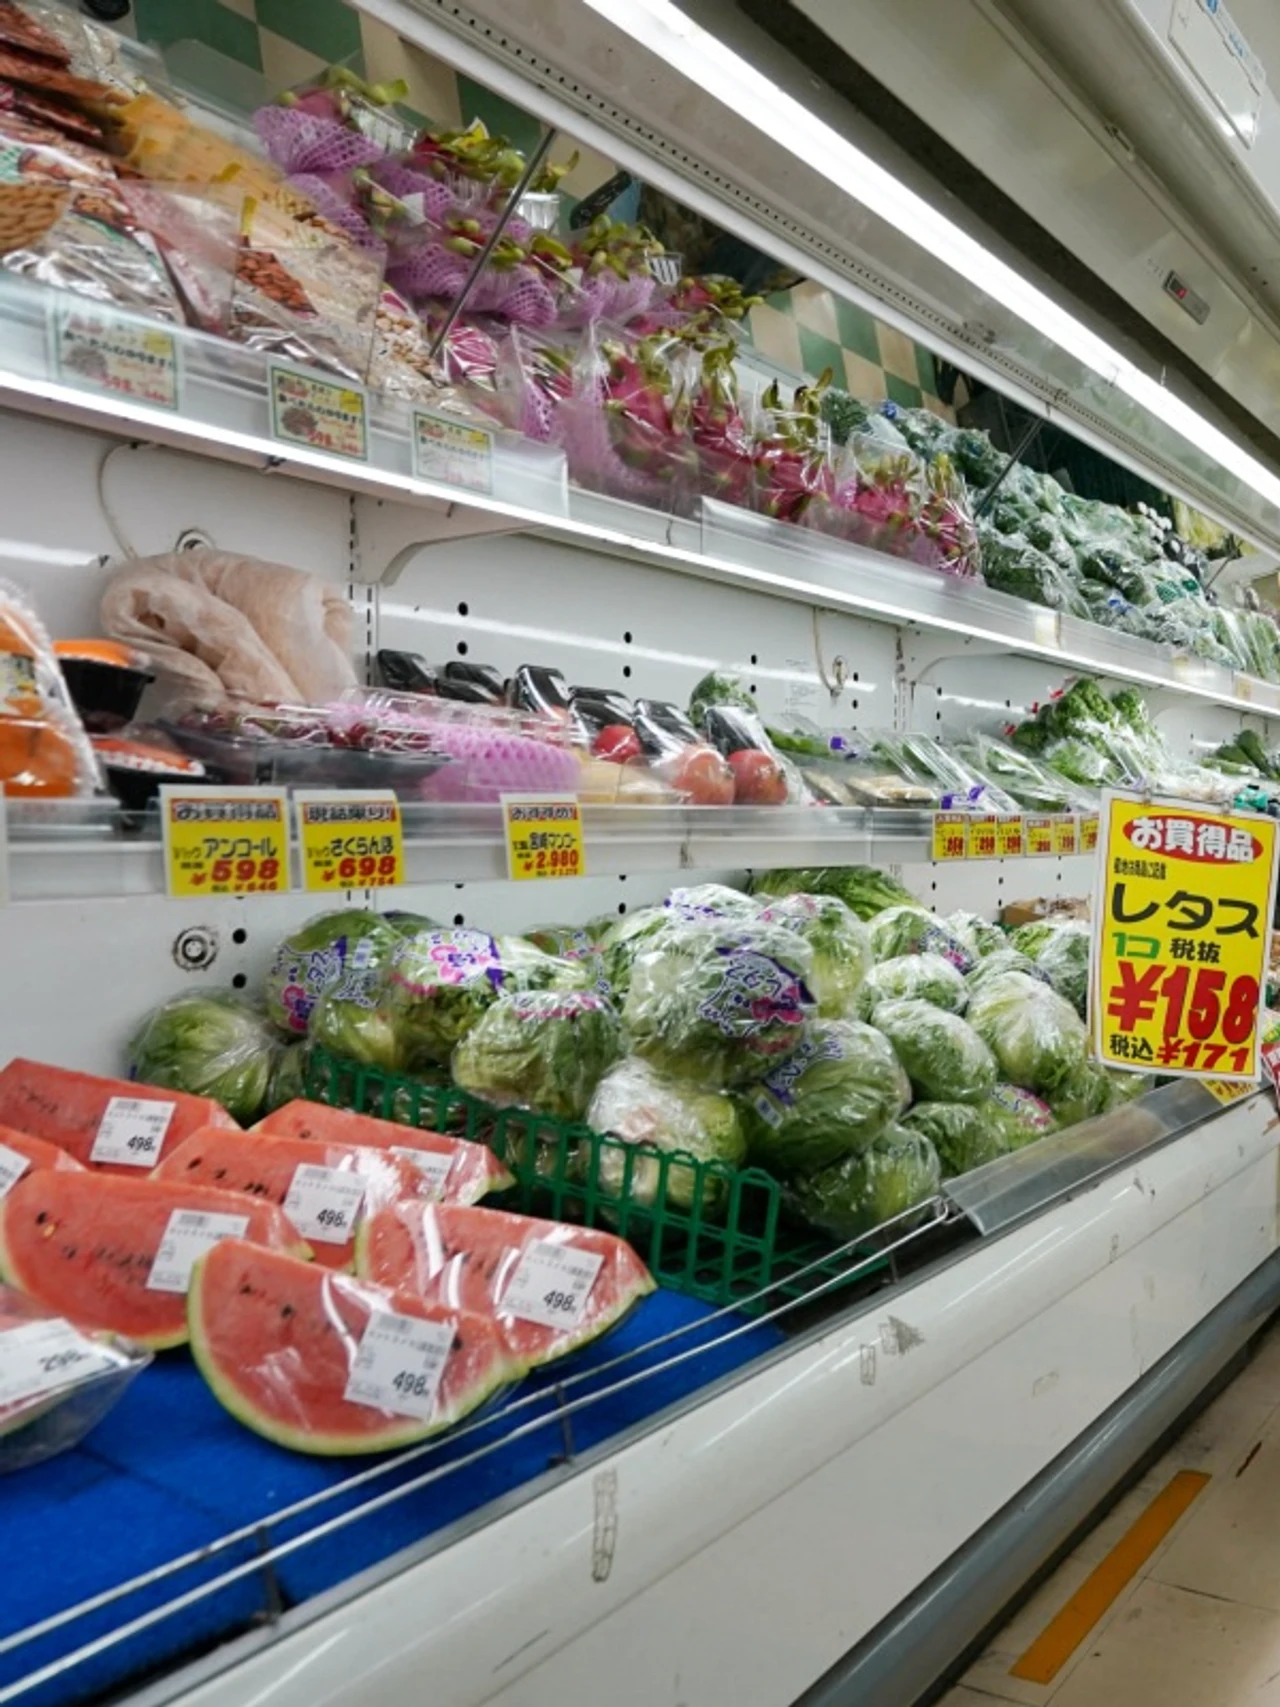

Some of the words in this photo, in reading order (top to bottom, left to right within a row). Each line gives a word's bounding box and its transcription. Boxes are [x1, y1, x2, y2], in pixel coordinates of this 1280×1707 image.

[203, 837, 278, 858] アンコール
[331, 836, 394, 857] さくらんぼ
[1130, 817, 1255, 864] お買得品
[190, 858, 279, 887] ¥598
[322, 855, 396, 882] ¥698
[1111, 882, 1260, 940] レタス
[1169, 937, 1221, 964] 税抜
[1107, 960, 1259, 1045] ¥158
[1109, 1034, 1154, 1062] 税込
[1156, 1038, 1250, 1073] ¥171
